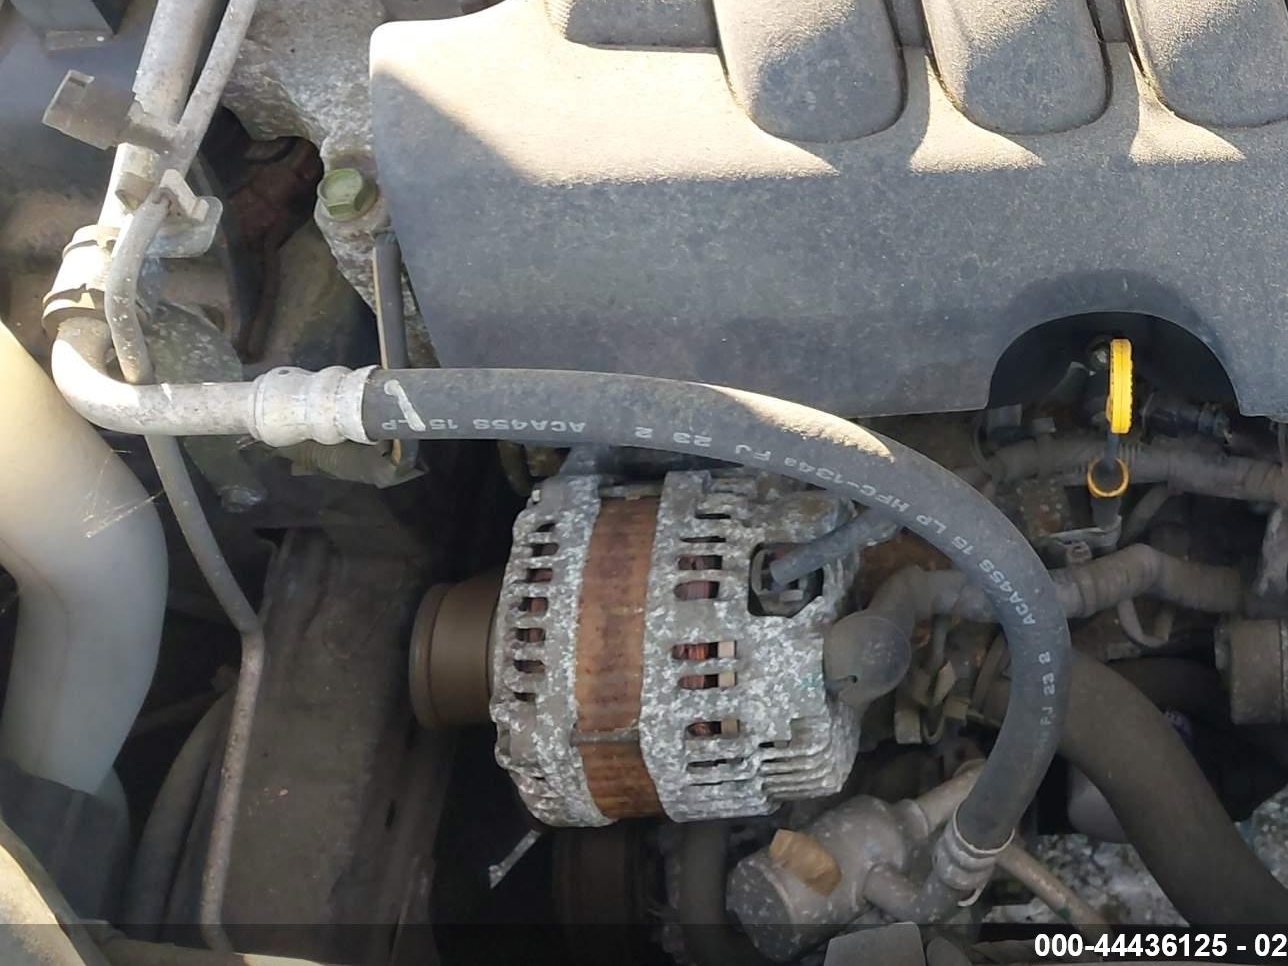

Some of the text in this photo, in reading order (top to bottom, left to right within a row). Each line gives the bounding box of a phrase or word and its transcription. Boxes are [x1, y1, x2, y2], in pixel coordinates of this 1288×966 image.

[429, 418, 458, 430] 15
[473, 418, 586, 433] ACA45S
[635, 426, 654, 439] 2
[672, 432, 712, 448] 23
[735, 444, 771, 462] FJ
[783, 457, 911, 513] HFC-134a
[916, 514, 948, 535] LP
[952, 535, 975, 555] 15
[979, 558, 1036, 626] ACA45S
